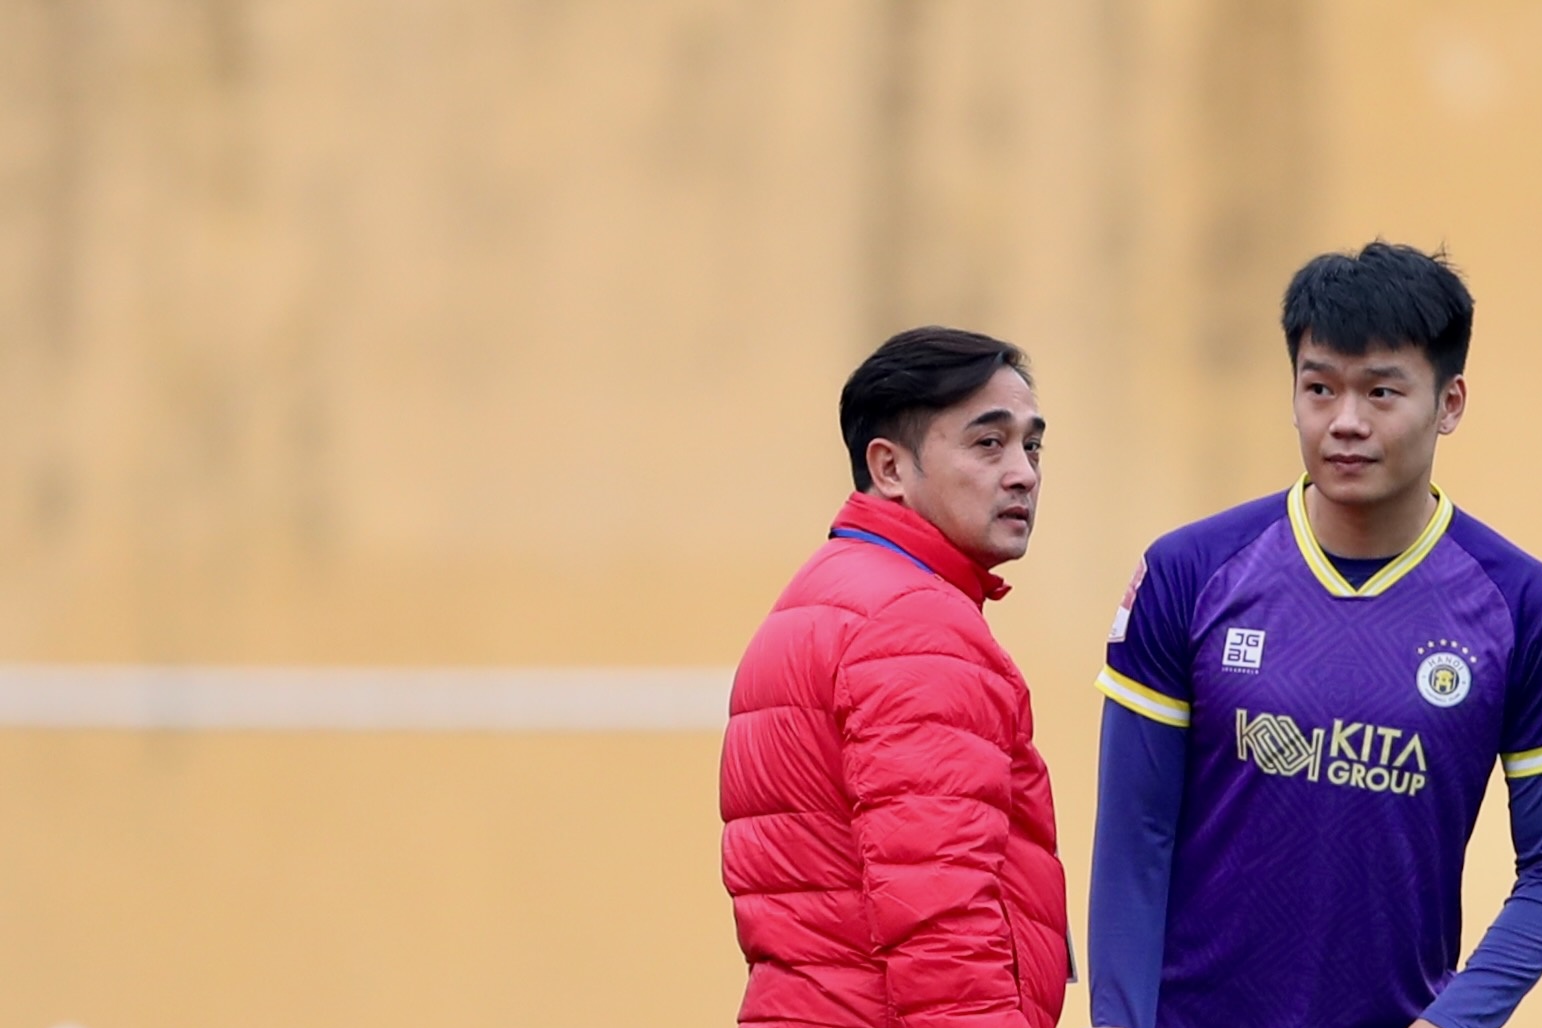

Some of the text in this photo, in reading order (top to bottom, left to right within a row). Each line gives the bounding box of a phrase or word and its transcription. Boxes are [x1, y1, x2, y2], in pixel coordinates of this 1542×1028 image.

[1428, 656, 1464, 671] HANOI
[1329, 718, 1427, 771] KITA
[1327, 760, 1426, 796] GROUP
